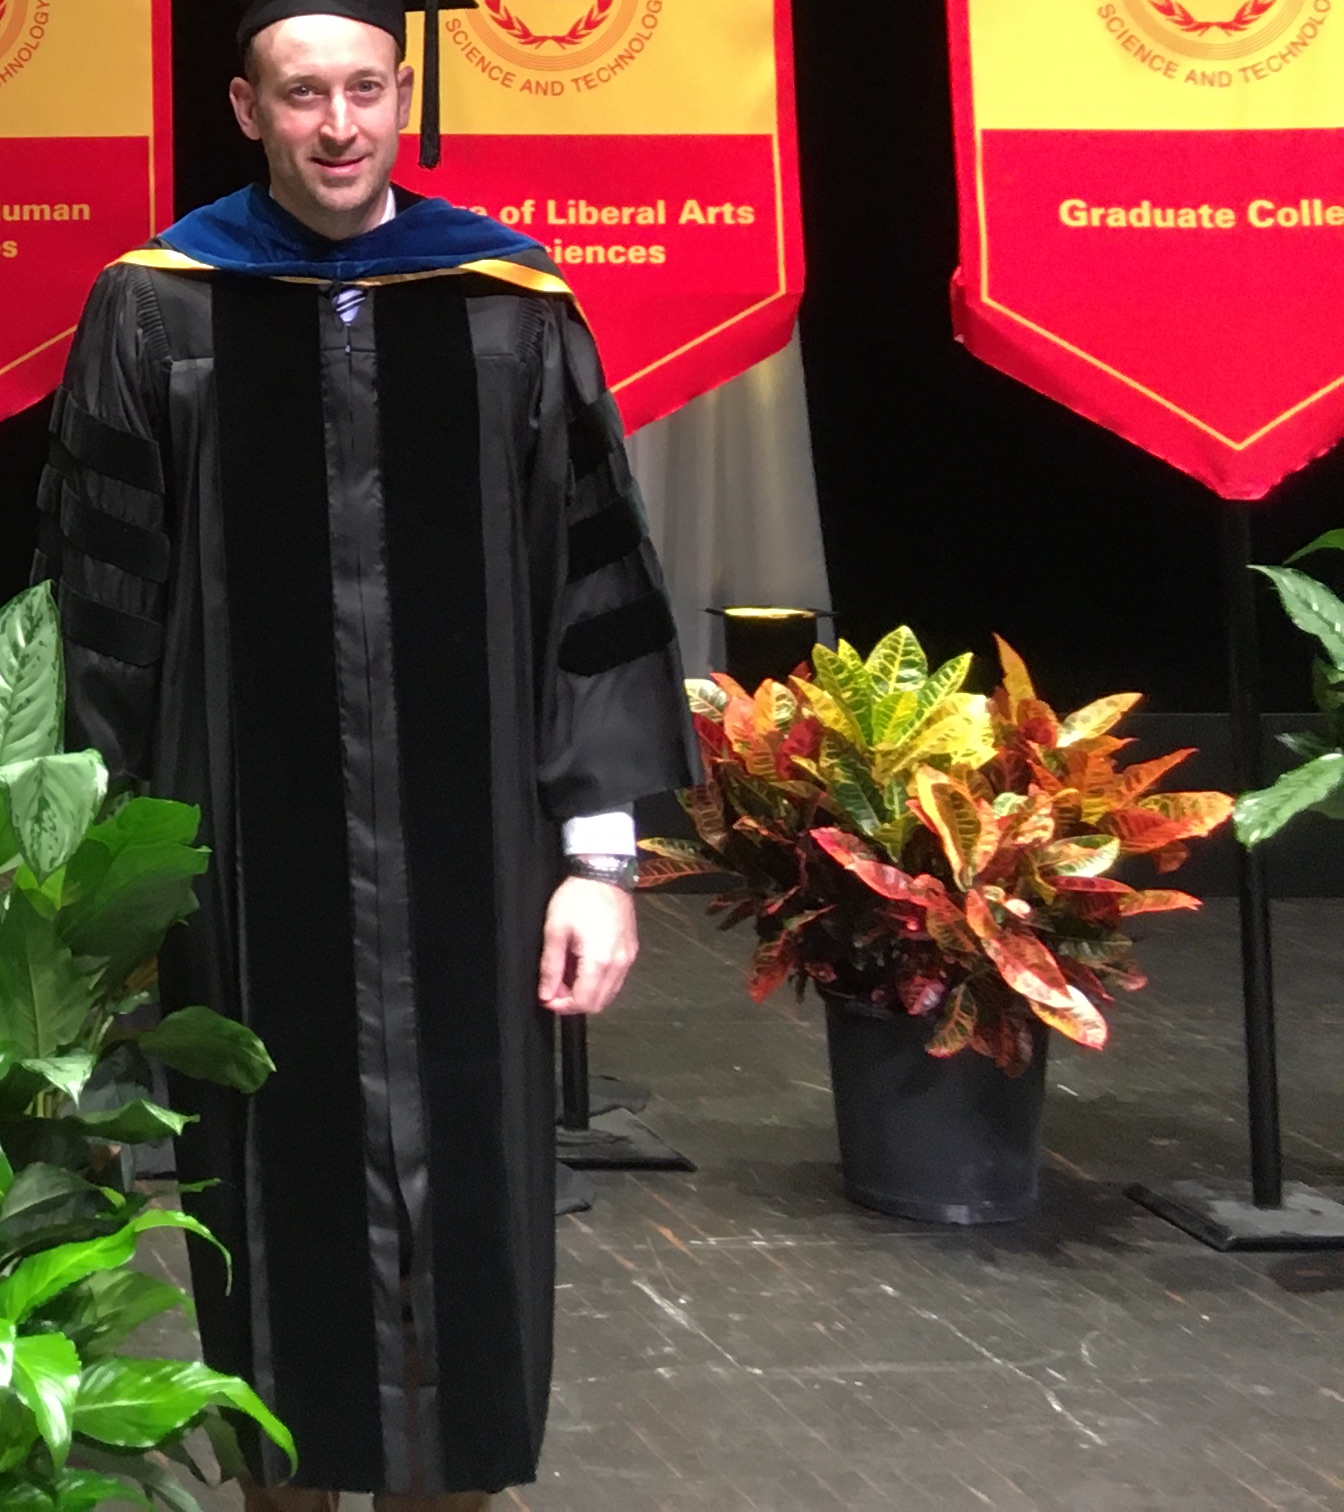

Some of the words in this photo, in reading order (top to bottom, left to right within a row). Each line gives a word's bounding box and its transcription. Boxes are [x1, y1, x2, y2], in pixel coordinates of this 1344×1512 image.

[447, 18, 516, 89] SCIENCE
[519, 79, 565, 97] AND
[500, 200, 535, 225] of
[548, 200, 665, 225] Liberal
[679, 200, 754, 224] Arts
[1059, 199, 1235, 228] Graduate
